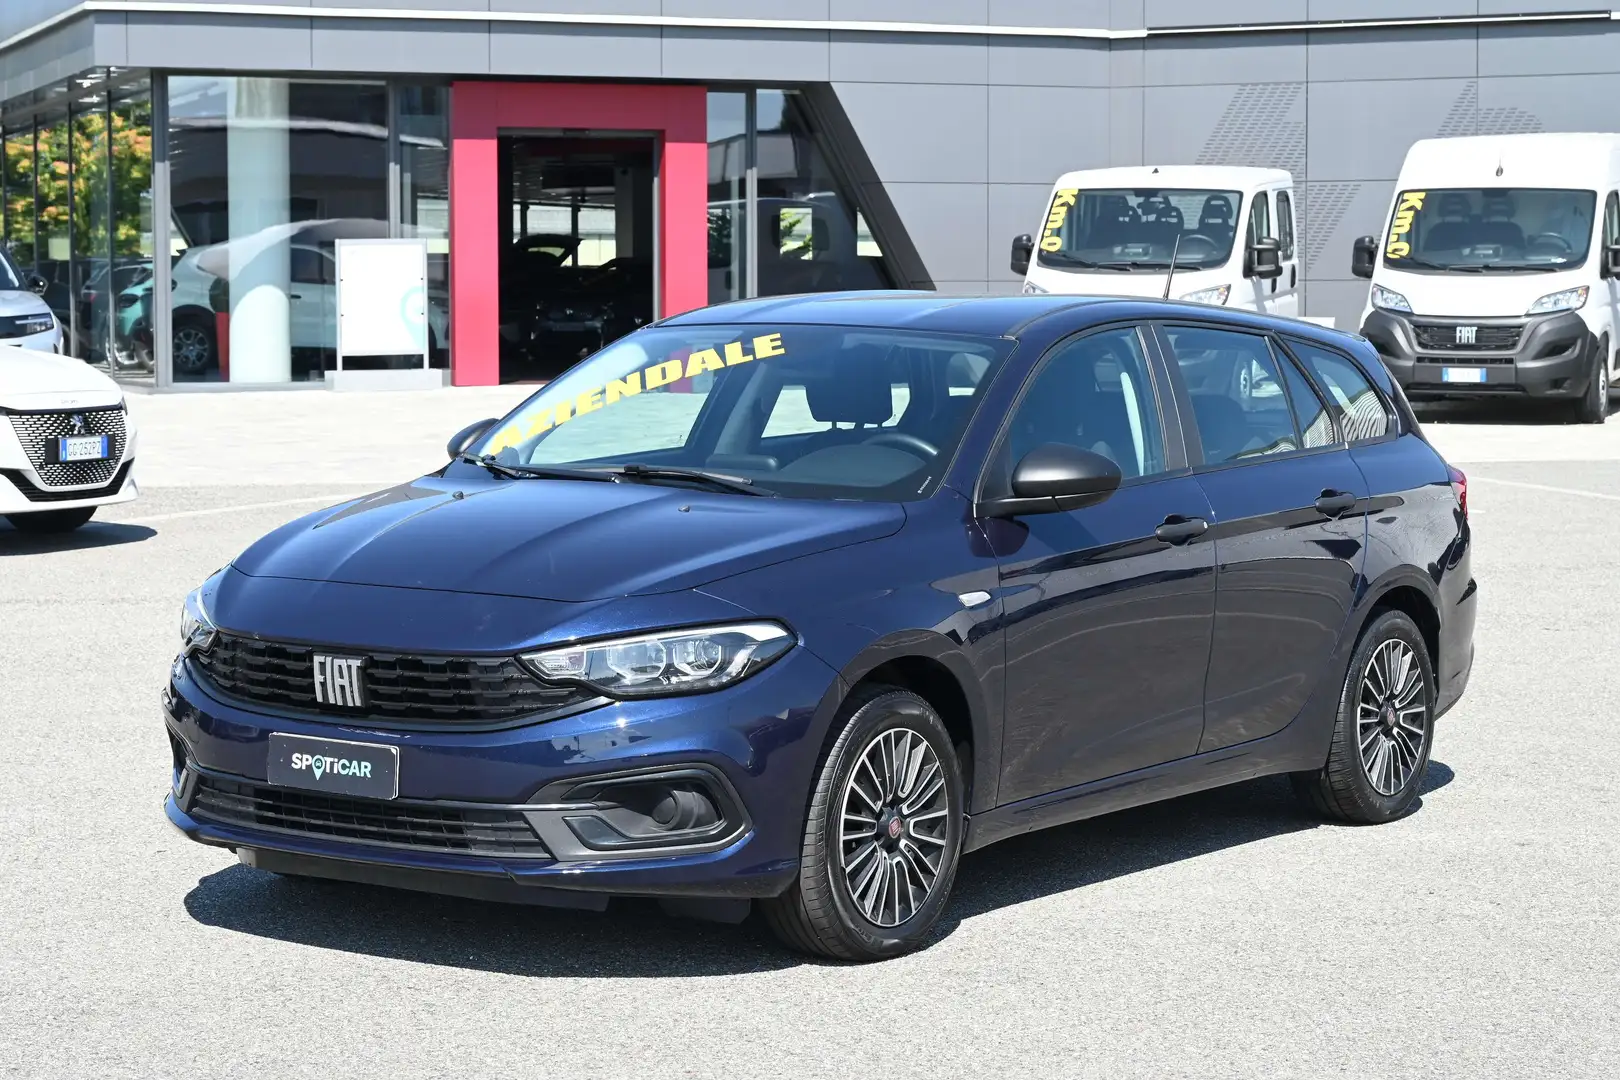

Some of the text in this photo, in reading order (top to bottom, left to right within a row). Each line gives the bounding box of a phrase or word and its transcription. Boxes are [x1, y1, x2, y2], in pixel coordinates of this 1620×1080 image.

[1456, 326, 1478, 344] FIAT
[490, 332, 786, 456] AZIENDALE
[313, 655, 363, 707] FIAT
